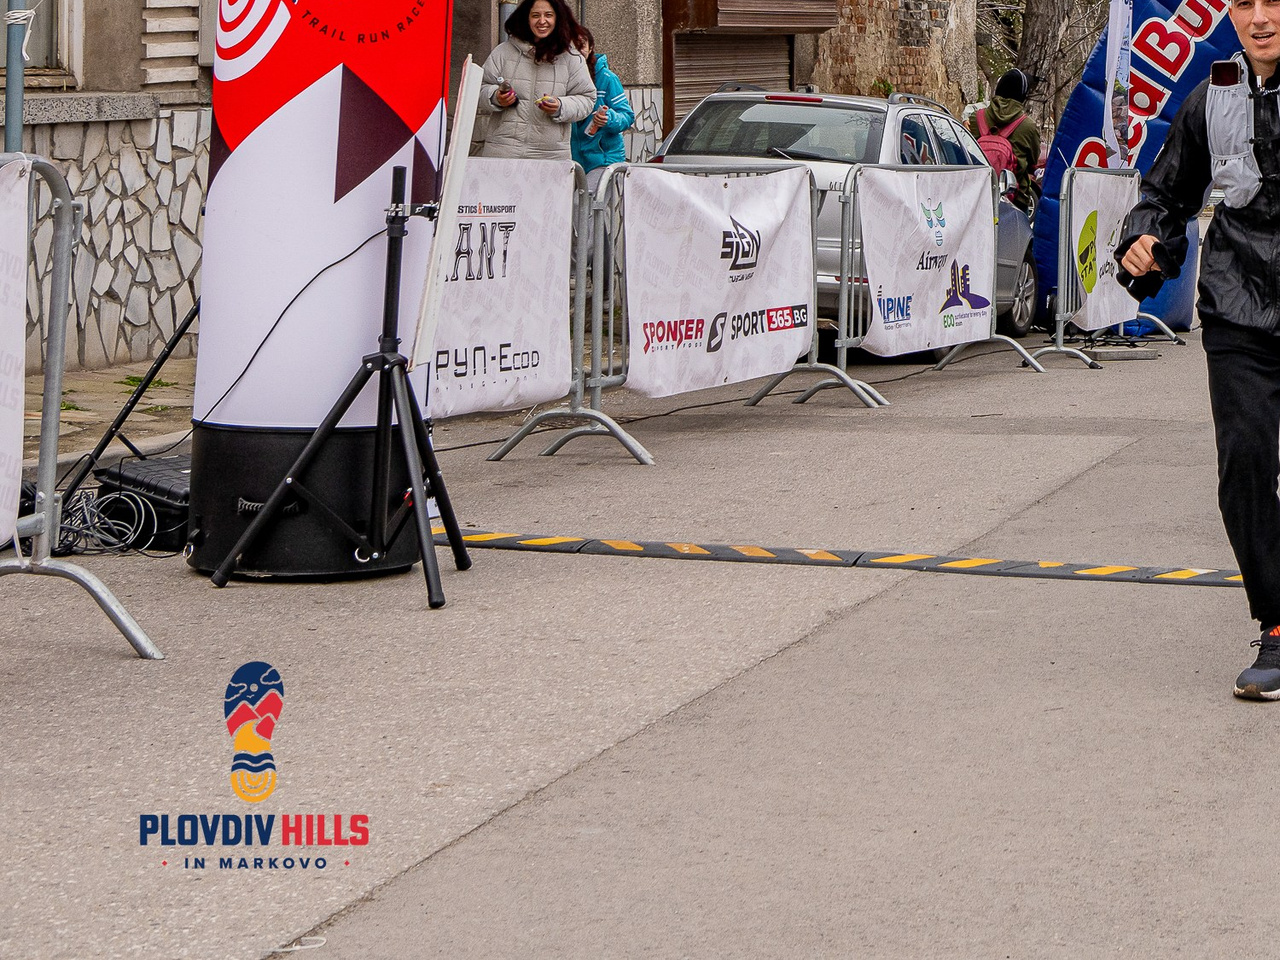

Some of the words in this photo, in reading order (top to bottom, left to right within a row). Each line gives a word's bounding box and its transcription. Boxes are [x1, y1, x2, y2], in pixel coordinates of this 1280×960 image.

[302, 9, 346, 41] TRAIL
[357, 30, 390, 43] RUN
[482, 205, 516, 214] TRANSPORT
[943, 314, 954, 328] ECO
[643, 319, 704, 354] SPONSER
